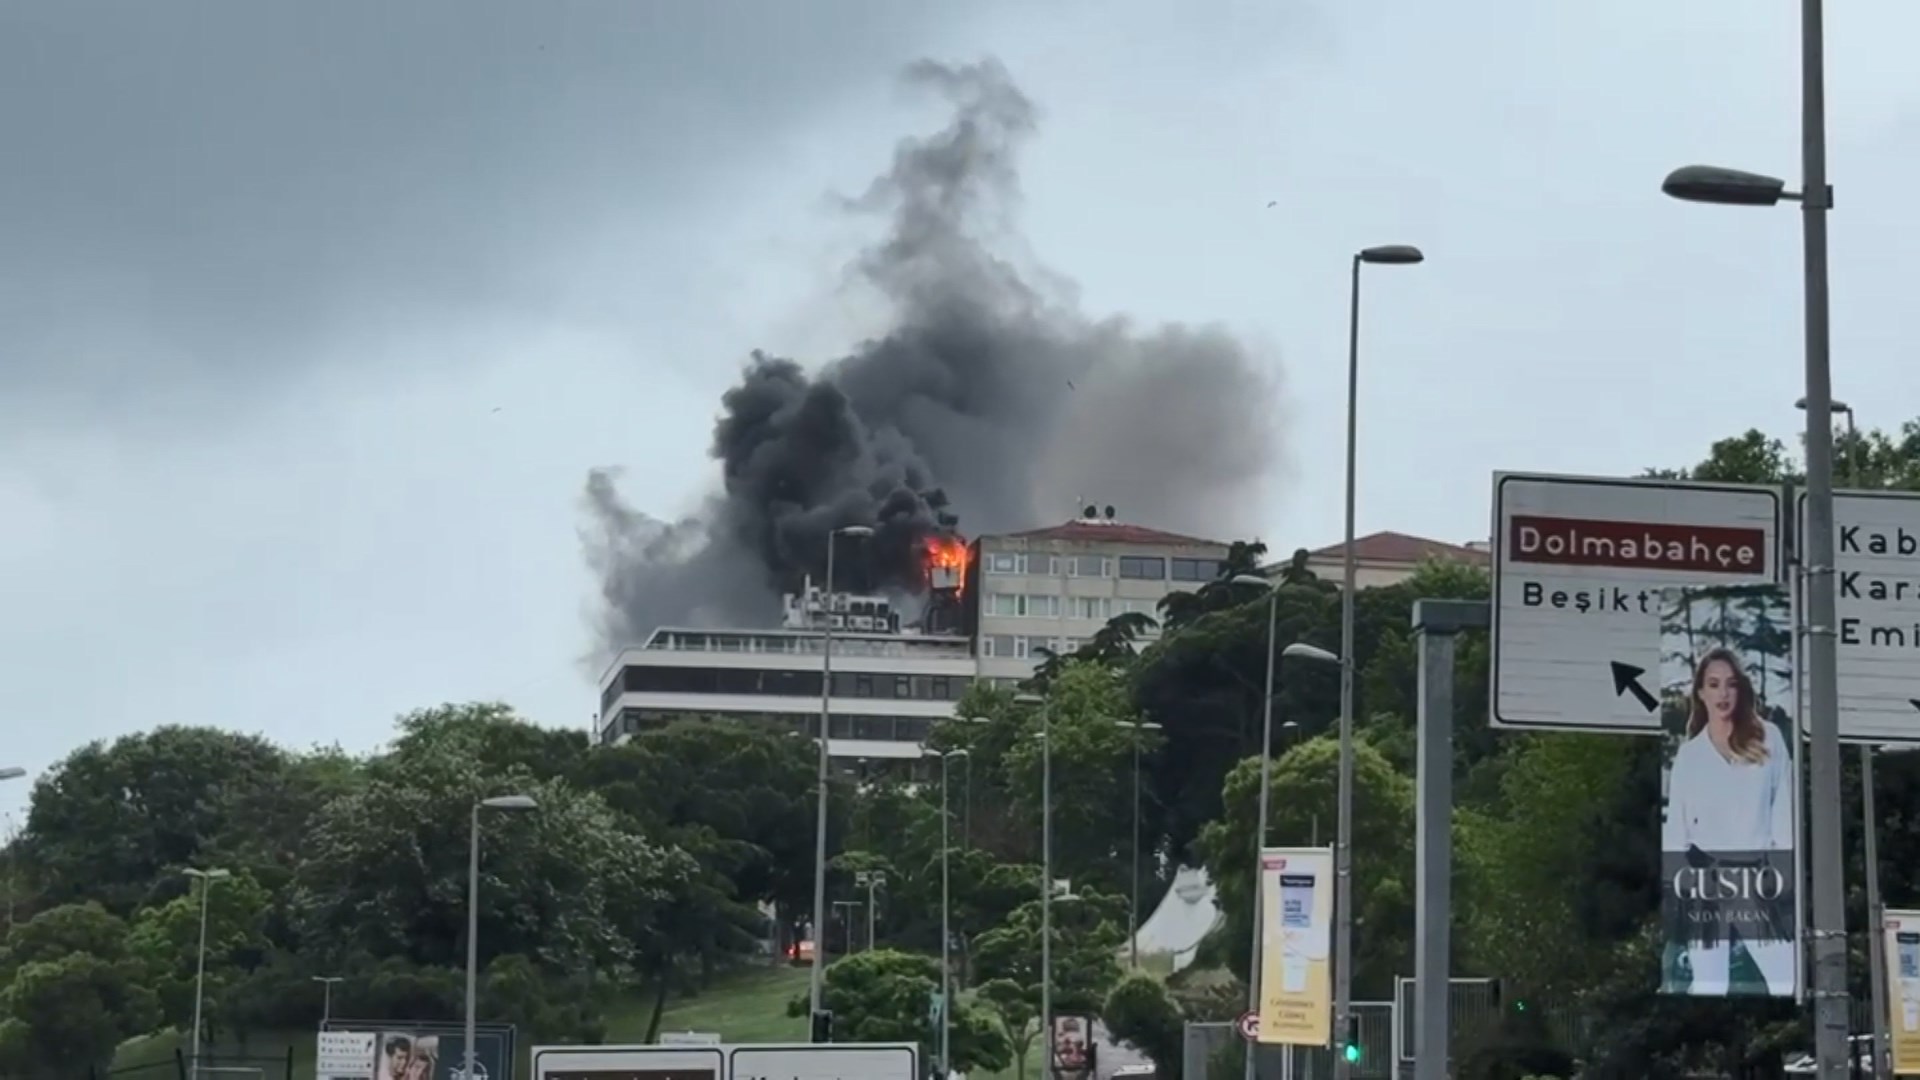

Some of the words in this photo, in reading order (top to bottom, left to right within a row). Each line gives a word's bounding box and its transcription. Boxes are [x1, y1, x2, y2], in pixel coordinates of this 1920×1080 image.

[1519, 526, 1755, 567] Dolmabahçe
[1840, 525, 1917, 555] Kab
[1523, 581, 1661, 613] Beşikt
[1840, 571, 1920, 601] Kar
[1840, 618, 1920, 648] Emi
[1674, 866, 1783, 900] GUSTO
